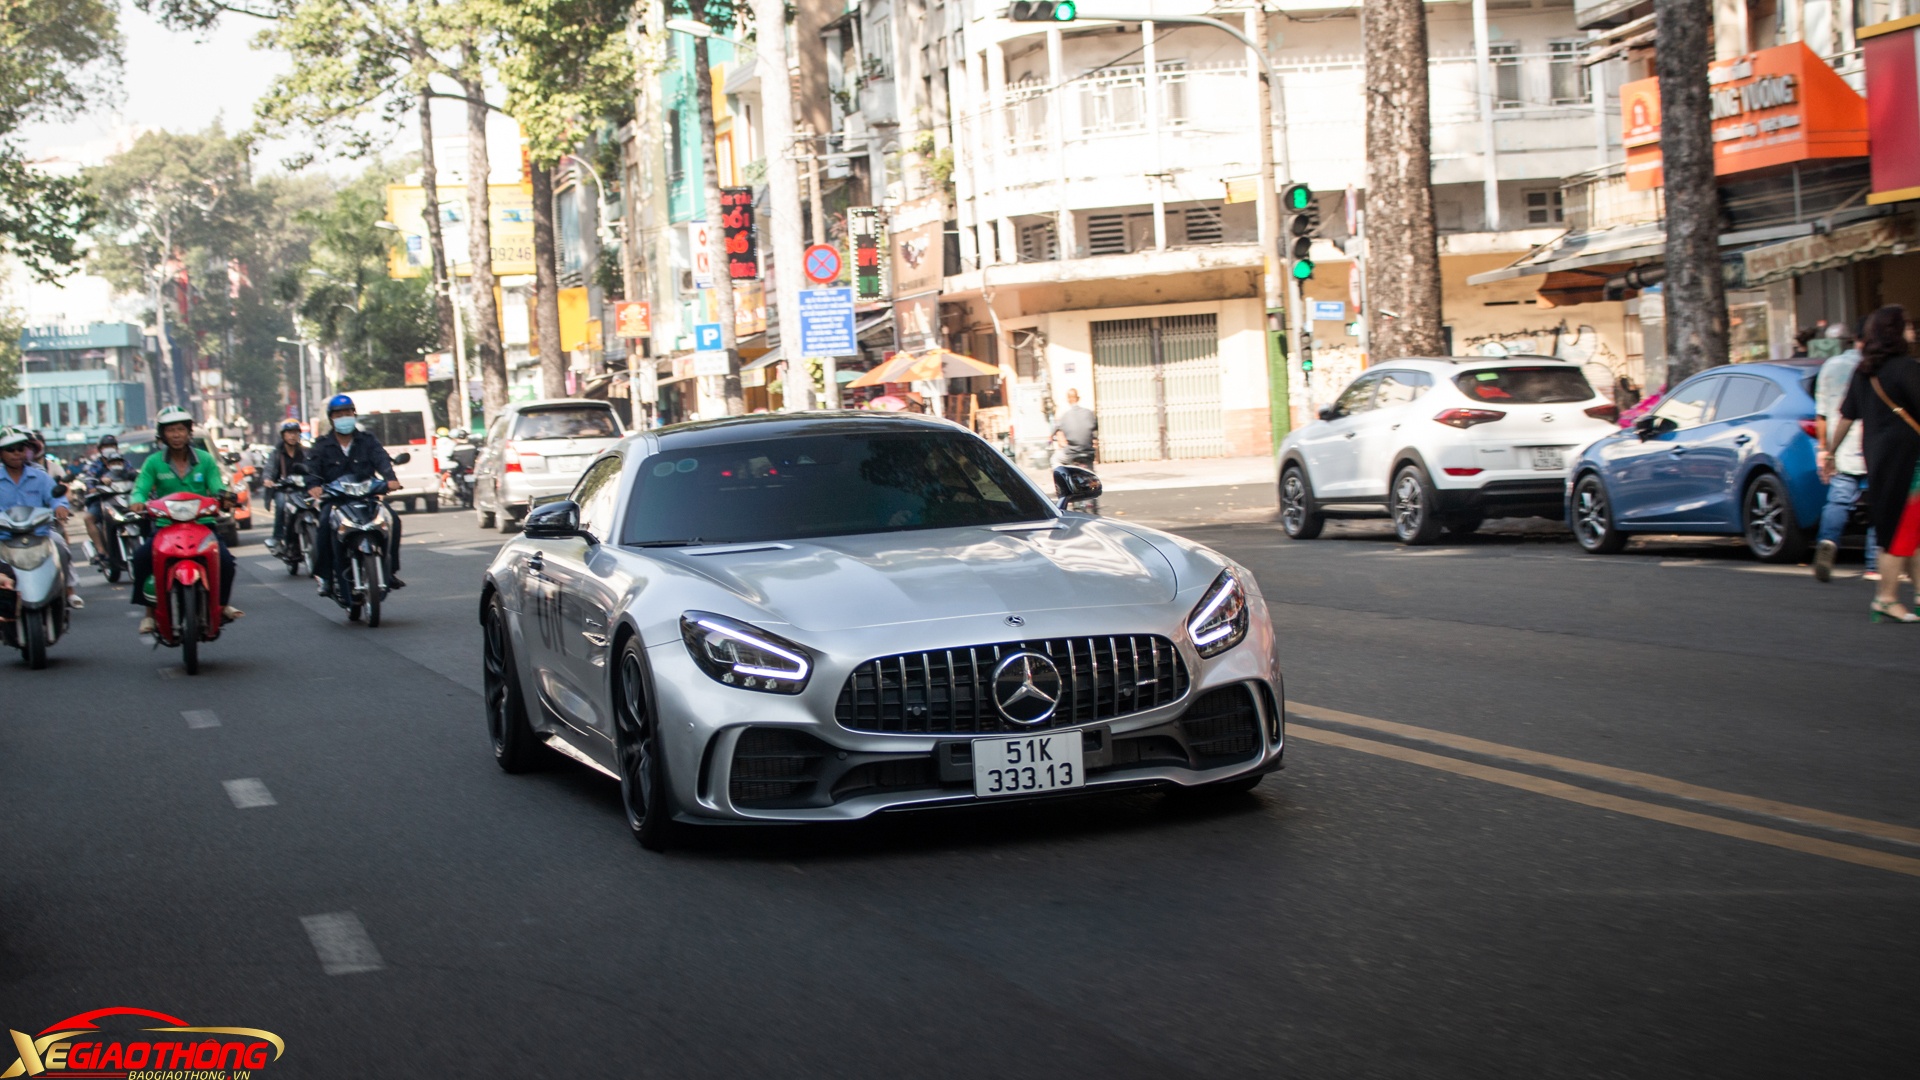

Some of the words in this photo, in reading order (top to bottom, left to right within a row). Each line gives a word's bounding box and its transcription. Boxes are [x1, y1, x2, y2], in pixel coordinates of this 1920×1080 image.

[702, 328, 719, 346] P
[1006, 737, 1053, 764] 51K
[988, 762, 1073, 792] 333.13
